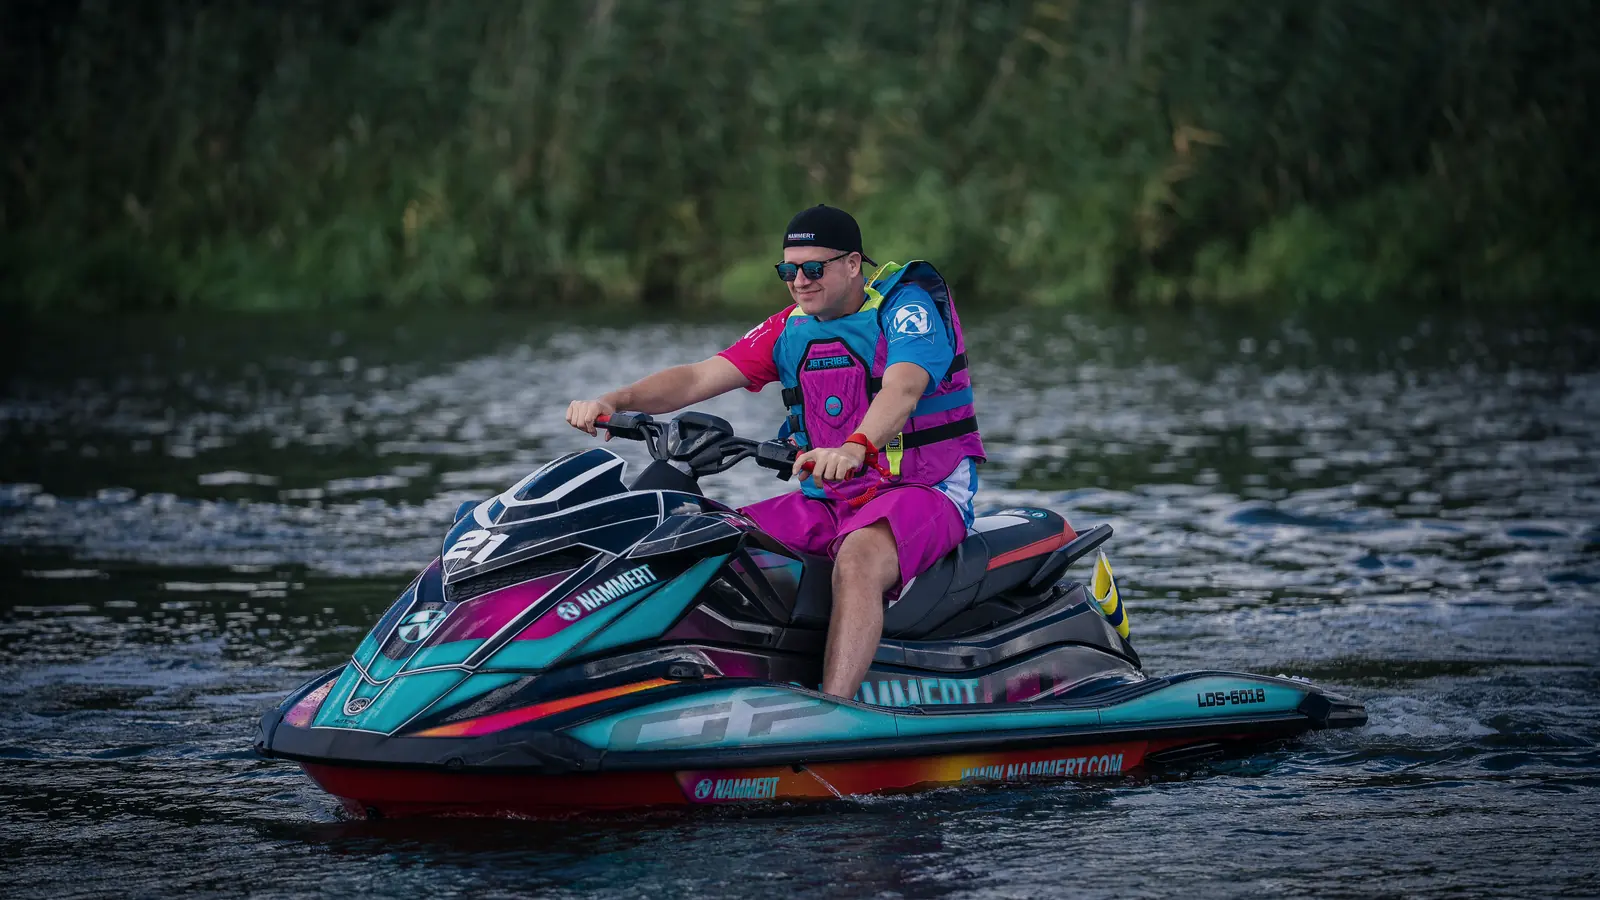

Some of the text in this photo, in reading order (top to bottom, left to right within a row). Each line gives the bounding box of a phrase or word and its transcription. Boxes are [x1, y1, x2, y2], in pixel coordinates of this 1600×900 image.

[808, 356, 850, 368] JETTRIBE
[443, 529, 510, 564] 21
[576, 564, 657, 611] NAMMERT
[1197, 688, 1265, 707] LDS-6018
[961, 753, 1124, 780] WWWNAMMERTCOM
[713, 777, 780, 799] NAMMERT
